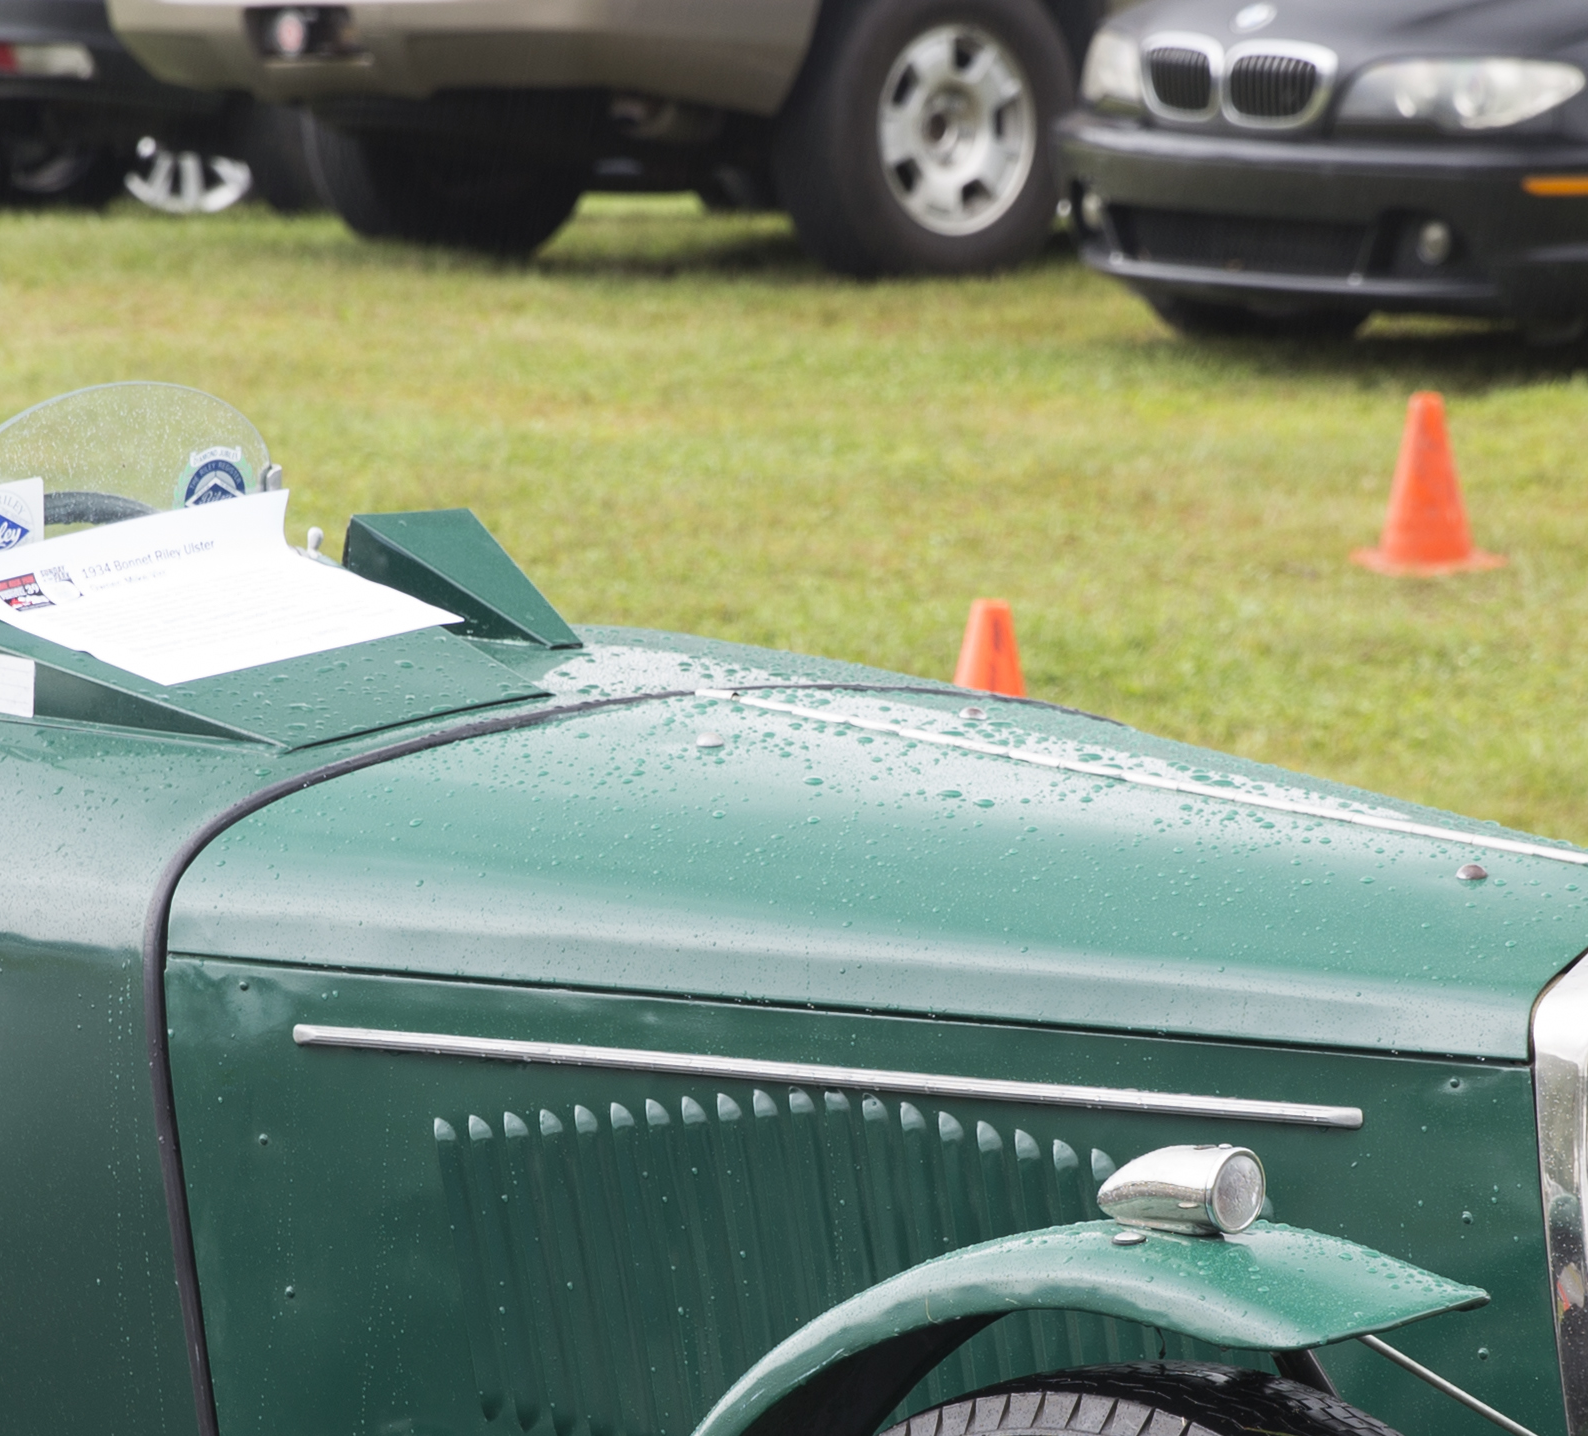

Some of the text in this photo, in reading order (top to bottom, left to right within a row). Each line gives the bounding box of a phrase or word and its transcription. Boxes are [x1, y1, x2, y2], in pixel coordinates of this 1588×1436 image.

[189, 461, 242, 489] THE RILEY REGISTER
[82, 540, 214, 579] 1934 Bonnet Riley Ulster
